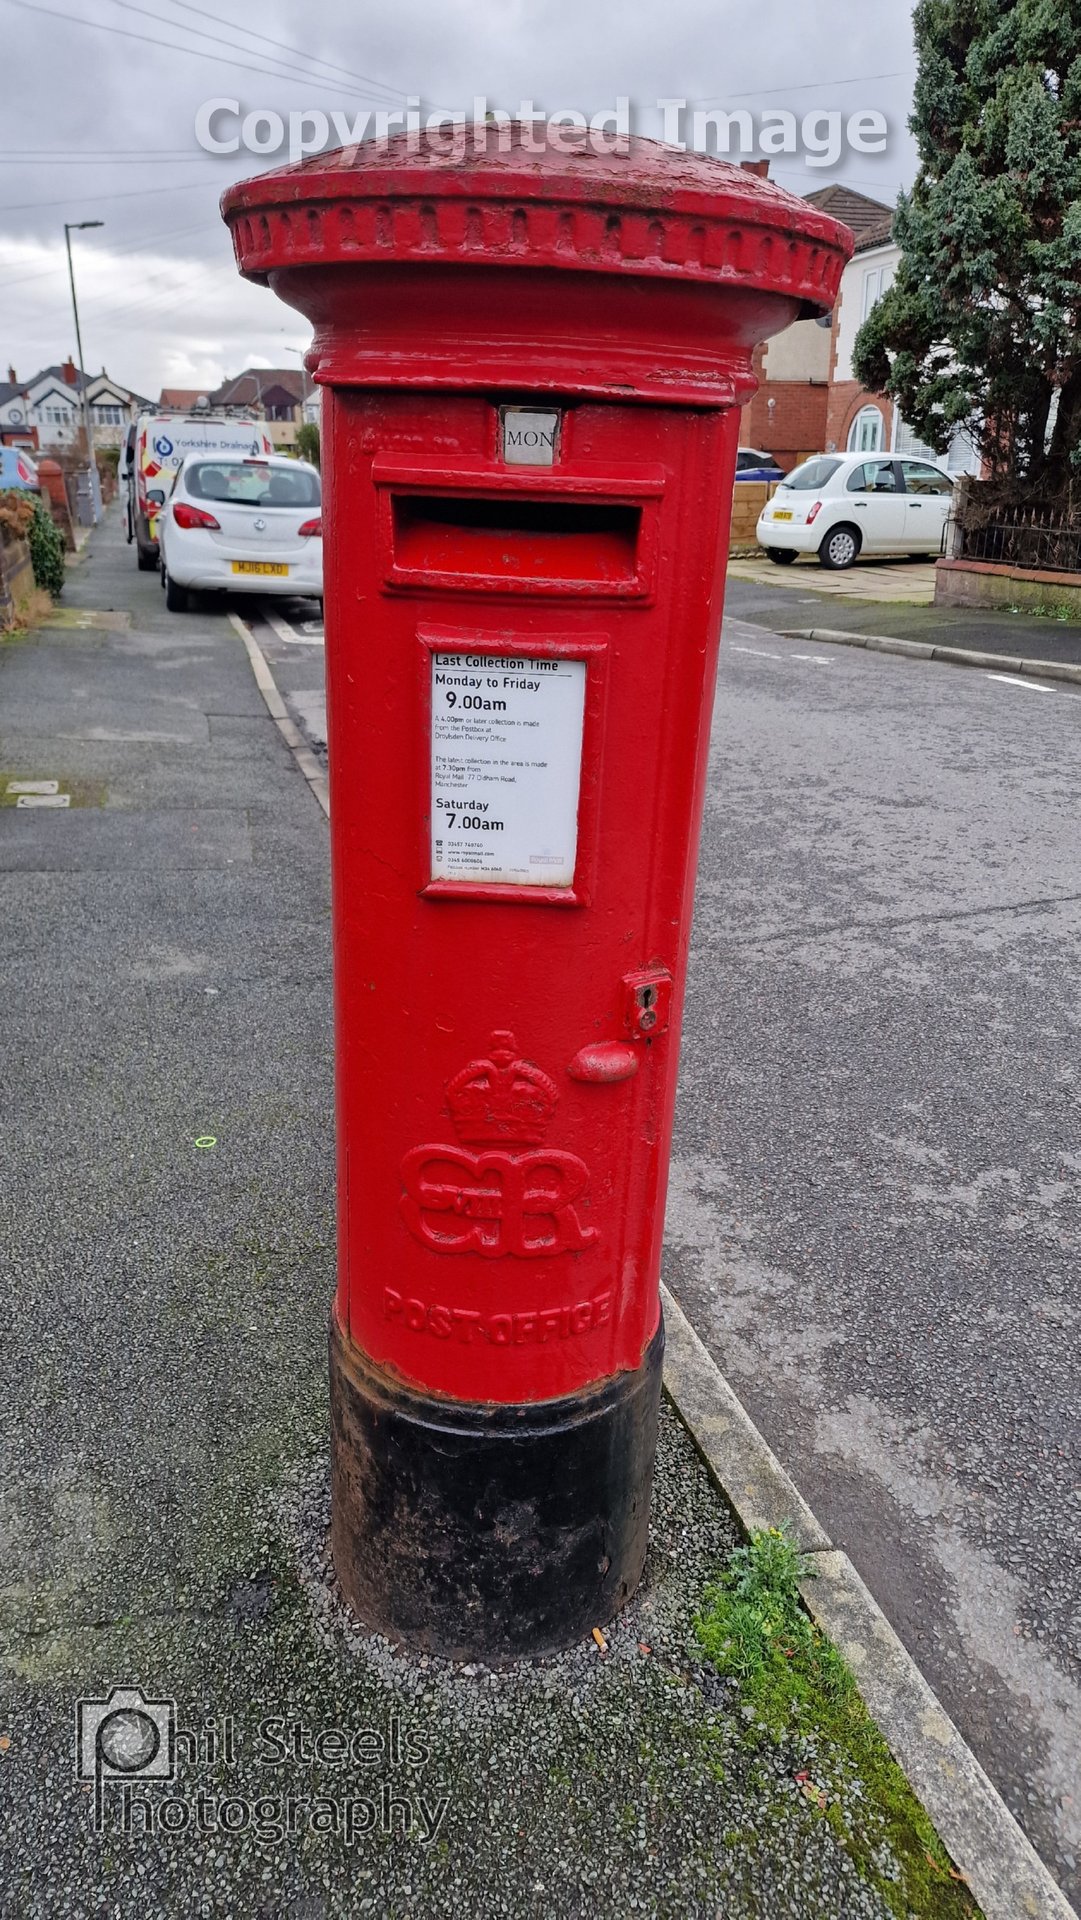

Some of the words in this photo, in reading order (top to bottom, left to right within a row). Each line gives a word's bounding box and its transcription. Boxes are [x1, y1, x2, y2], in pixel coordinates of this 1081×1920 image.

[175, 439, 217, 448] Yorkshire
[506, 430, 554, 447] MON
[435, 654, 461, 666] Last
[466, 656, 524, 669] Collection
[528, 659, 559, 671] Time
[435, 673, 482, 689] Monday
[487, 677, 499, 688] to
[503, 677, 541, 692] Friday
[446, 691, 507, 711] 9.00am
[488, 718, 515, 726] collection
[465, 734, 488, 742] Delivery
[435, 798, 489, 812] Saturday
[446, 813, 504, 831] 7.00am
[383, 1286, 482, 1344] POST
[487, 1291, 612, 1346] OFFICE
